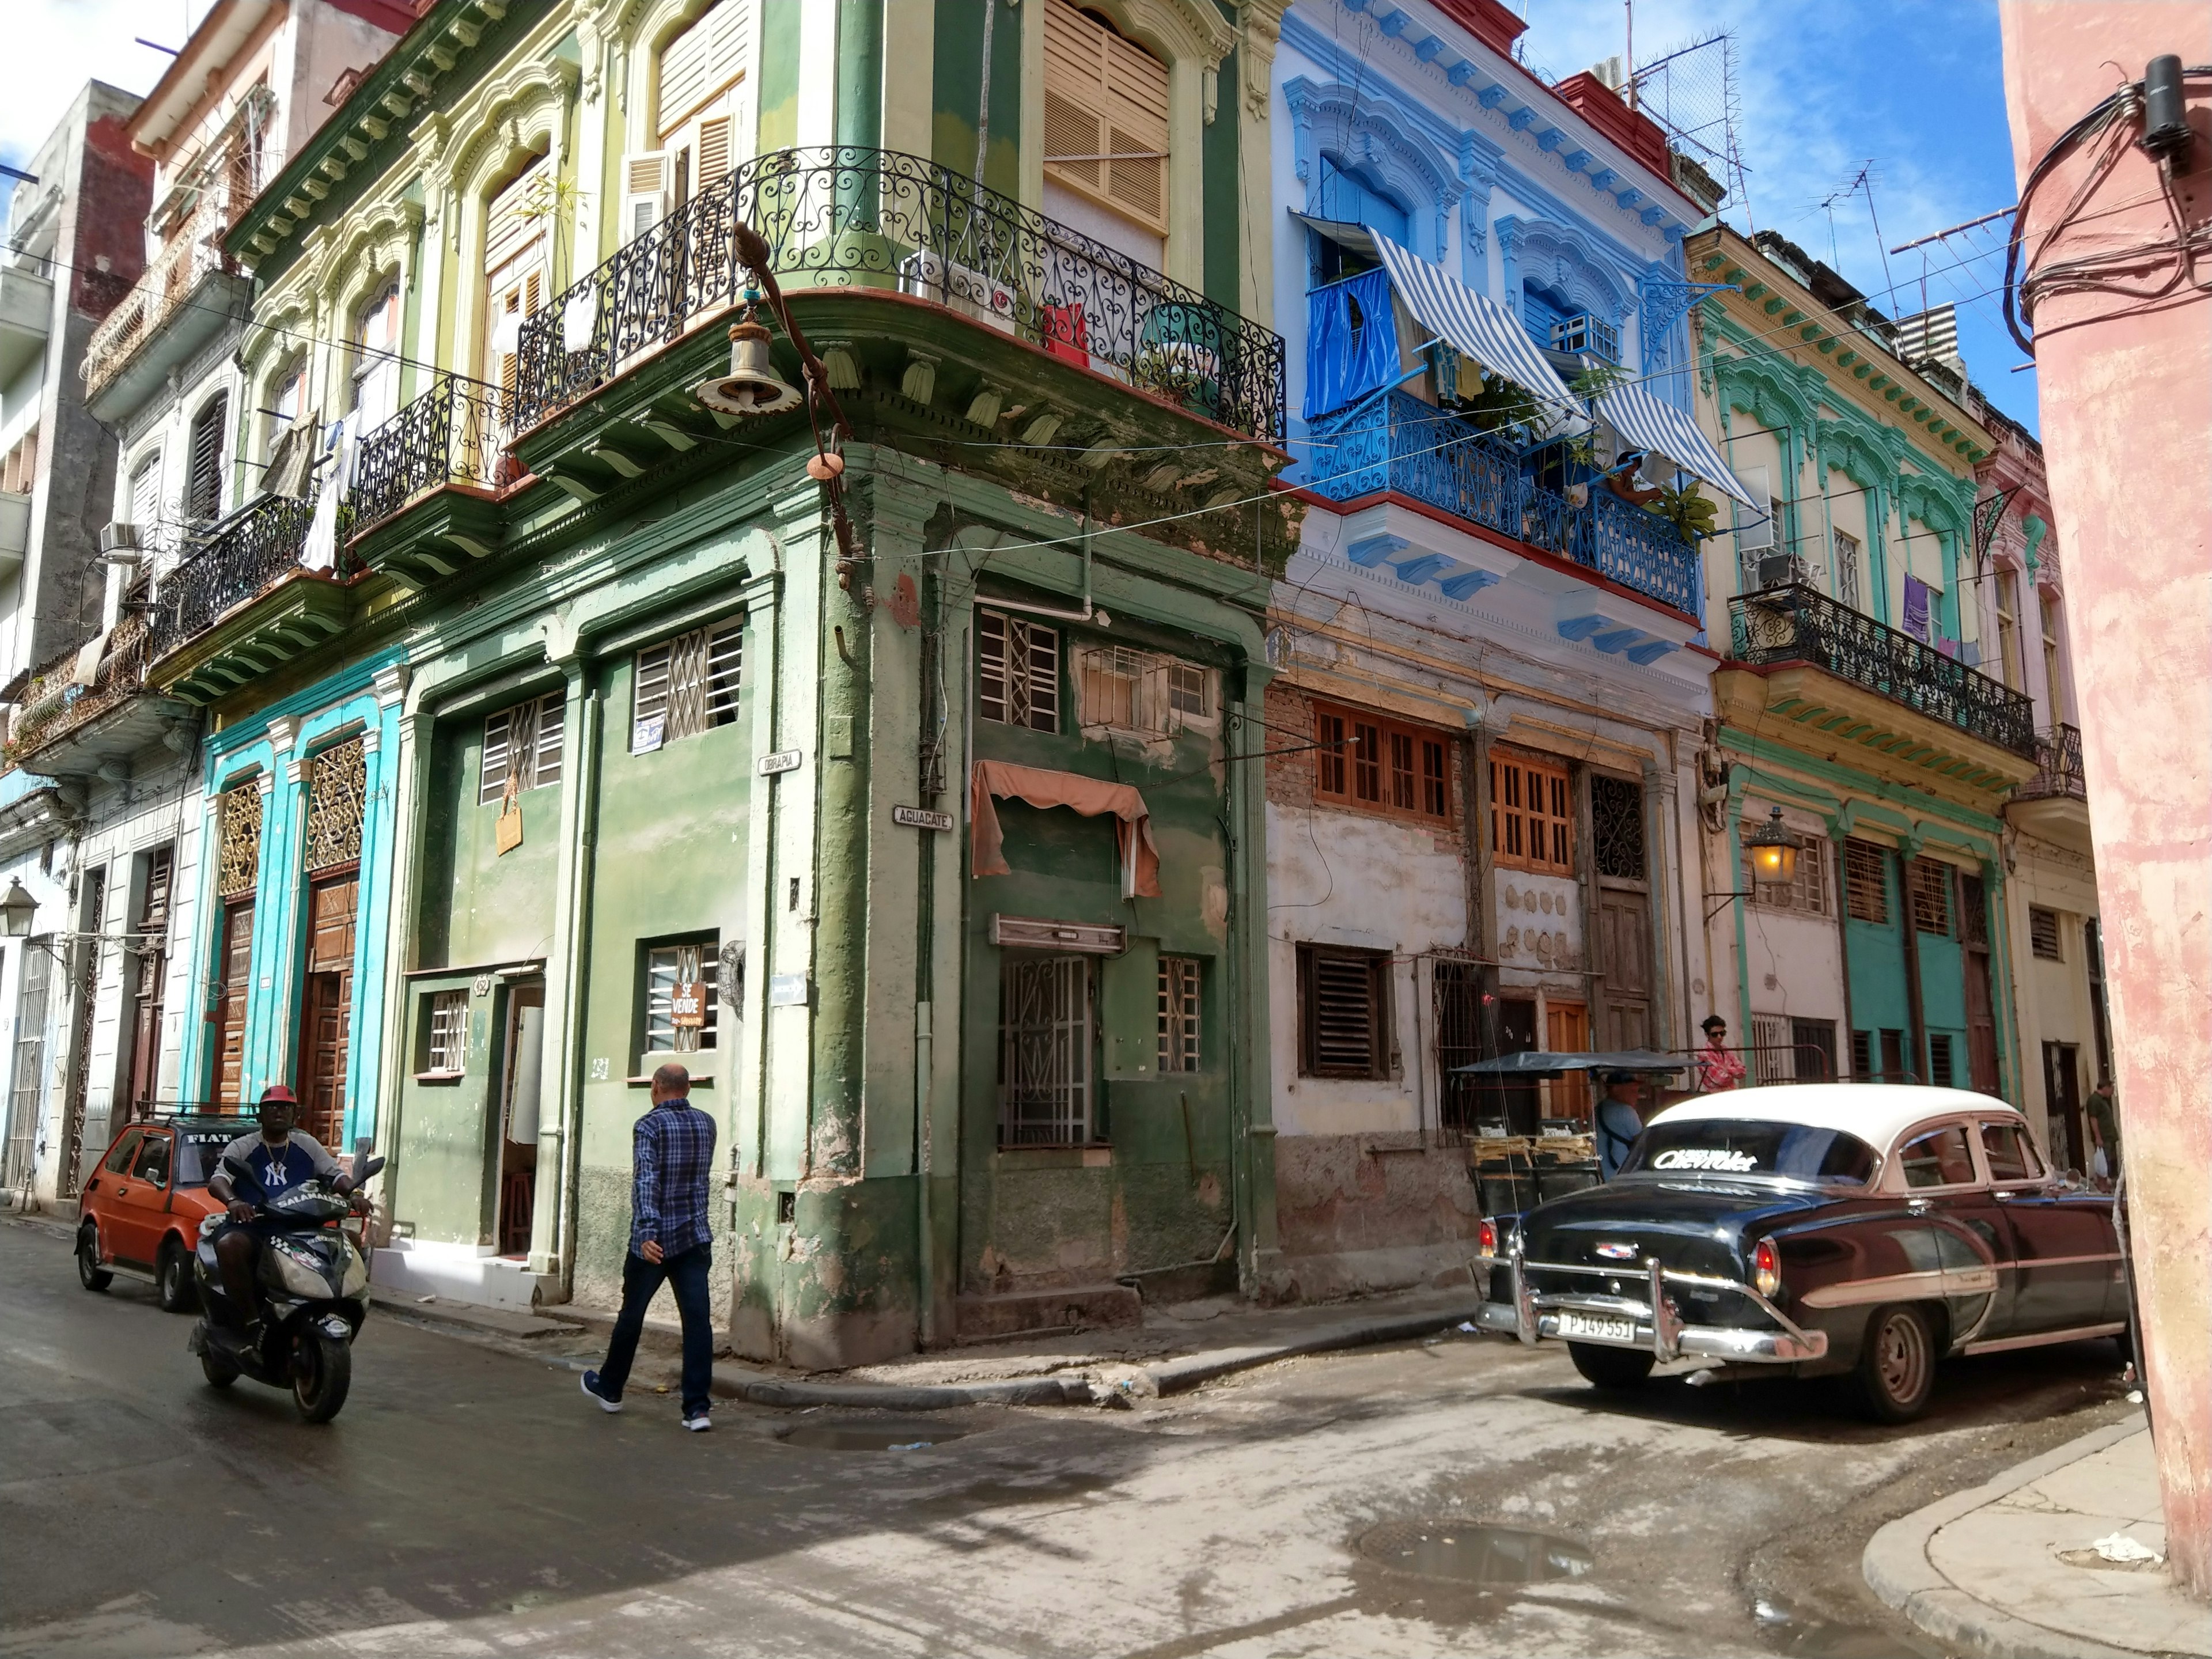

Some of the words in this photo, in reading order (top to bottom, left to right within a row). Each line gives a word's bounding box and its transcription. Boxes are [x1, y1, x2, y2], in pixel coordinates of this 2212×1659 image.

[765, 754, 793, 771] OBRAPIA
[899, 809, 948, 827] AGUACATE
[476, 980, 487, 992] 452
[682, 983, 692, 998] SE
[672, 998, 699, 1014] VENDE
[187, 1134, 232, 1143] FIAT
[1654, 1150, 1758, 1172] Chevrolet
[264, 1161, 287, 1187] NY
[1571, 1315, 1578, 1332] P
[1581, 1317, 1604, 1335] 149
[1607, 1319, 1630, 1338] 551
